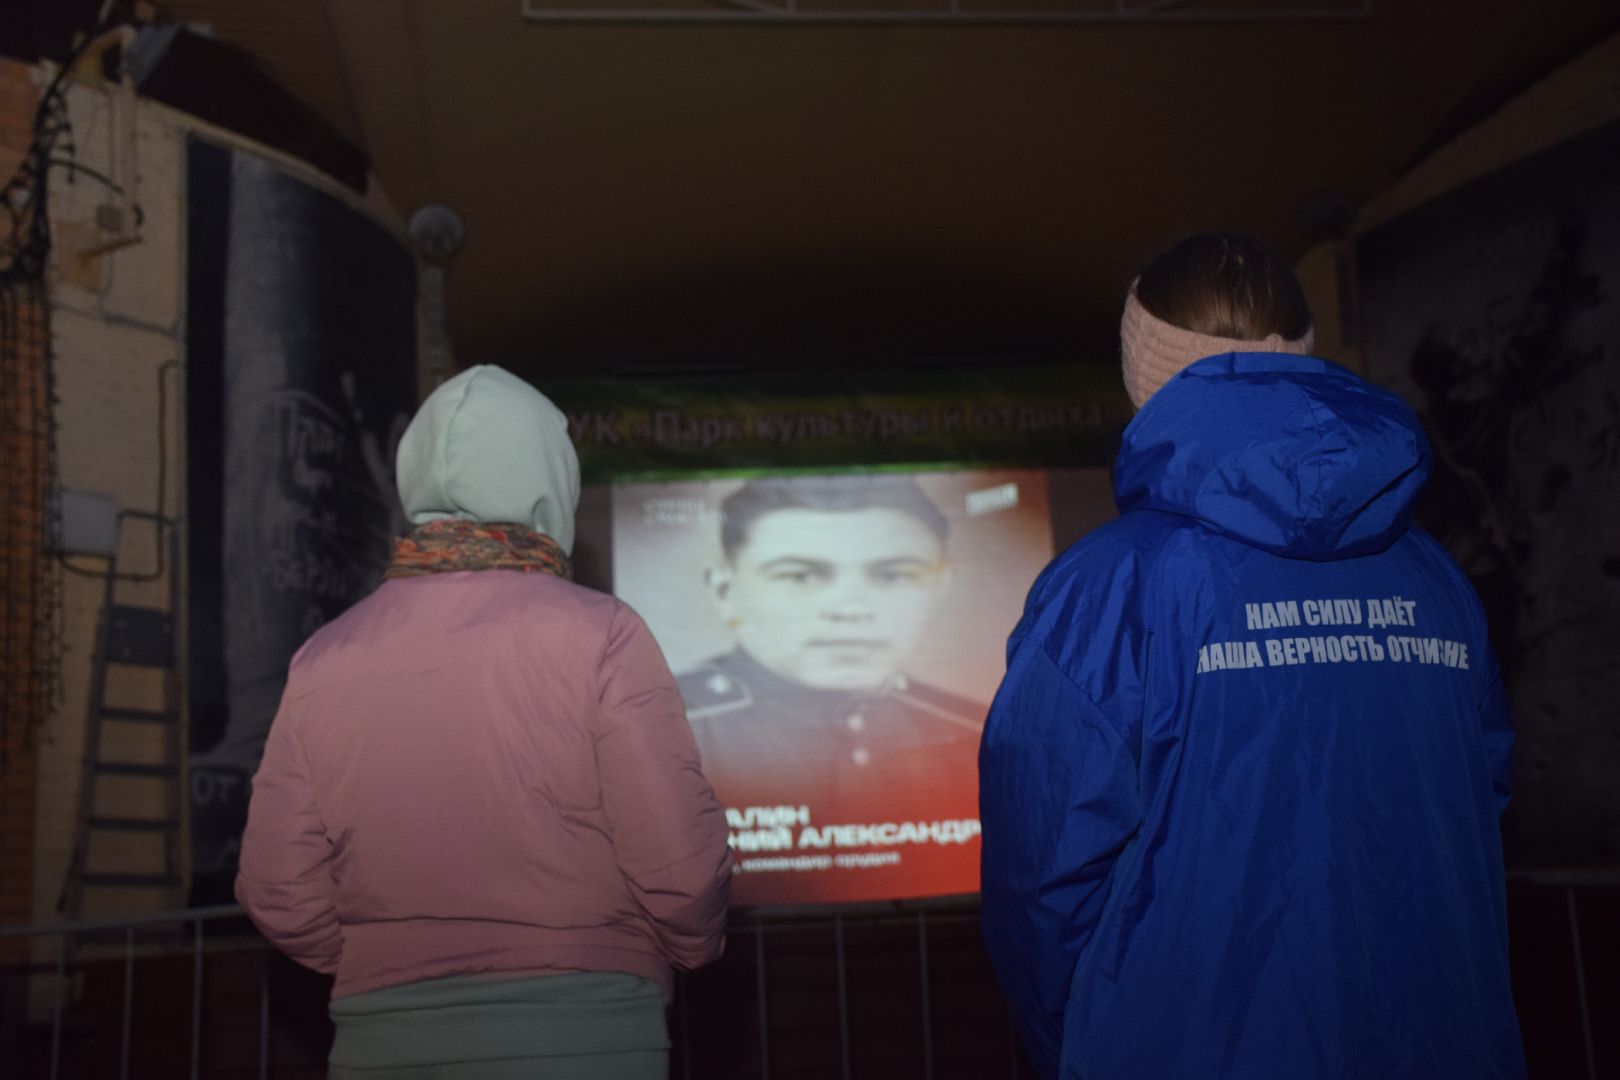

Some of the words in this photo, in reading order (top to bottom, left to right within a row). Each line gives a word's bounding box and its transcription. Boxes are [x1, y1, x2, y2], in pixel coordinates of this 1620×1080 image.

[756, 408, 928, 447] культуры
[1245, 600, 1300, 630] НАМ
[1302, 599, 1362, 627] СИЛУ
[1367, 596, 1416, 629] ДАЁТ
[1265, 635, 1384, 667] ВЕРНОСТЬ
